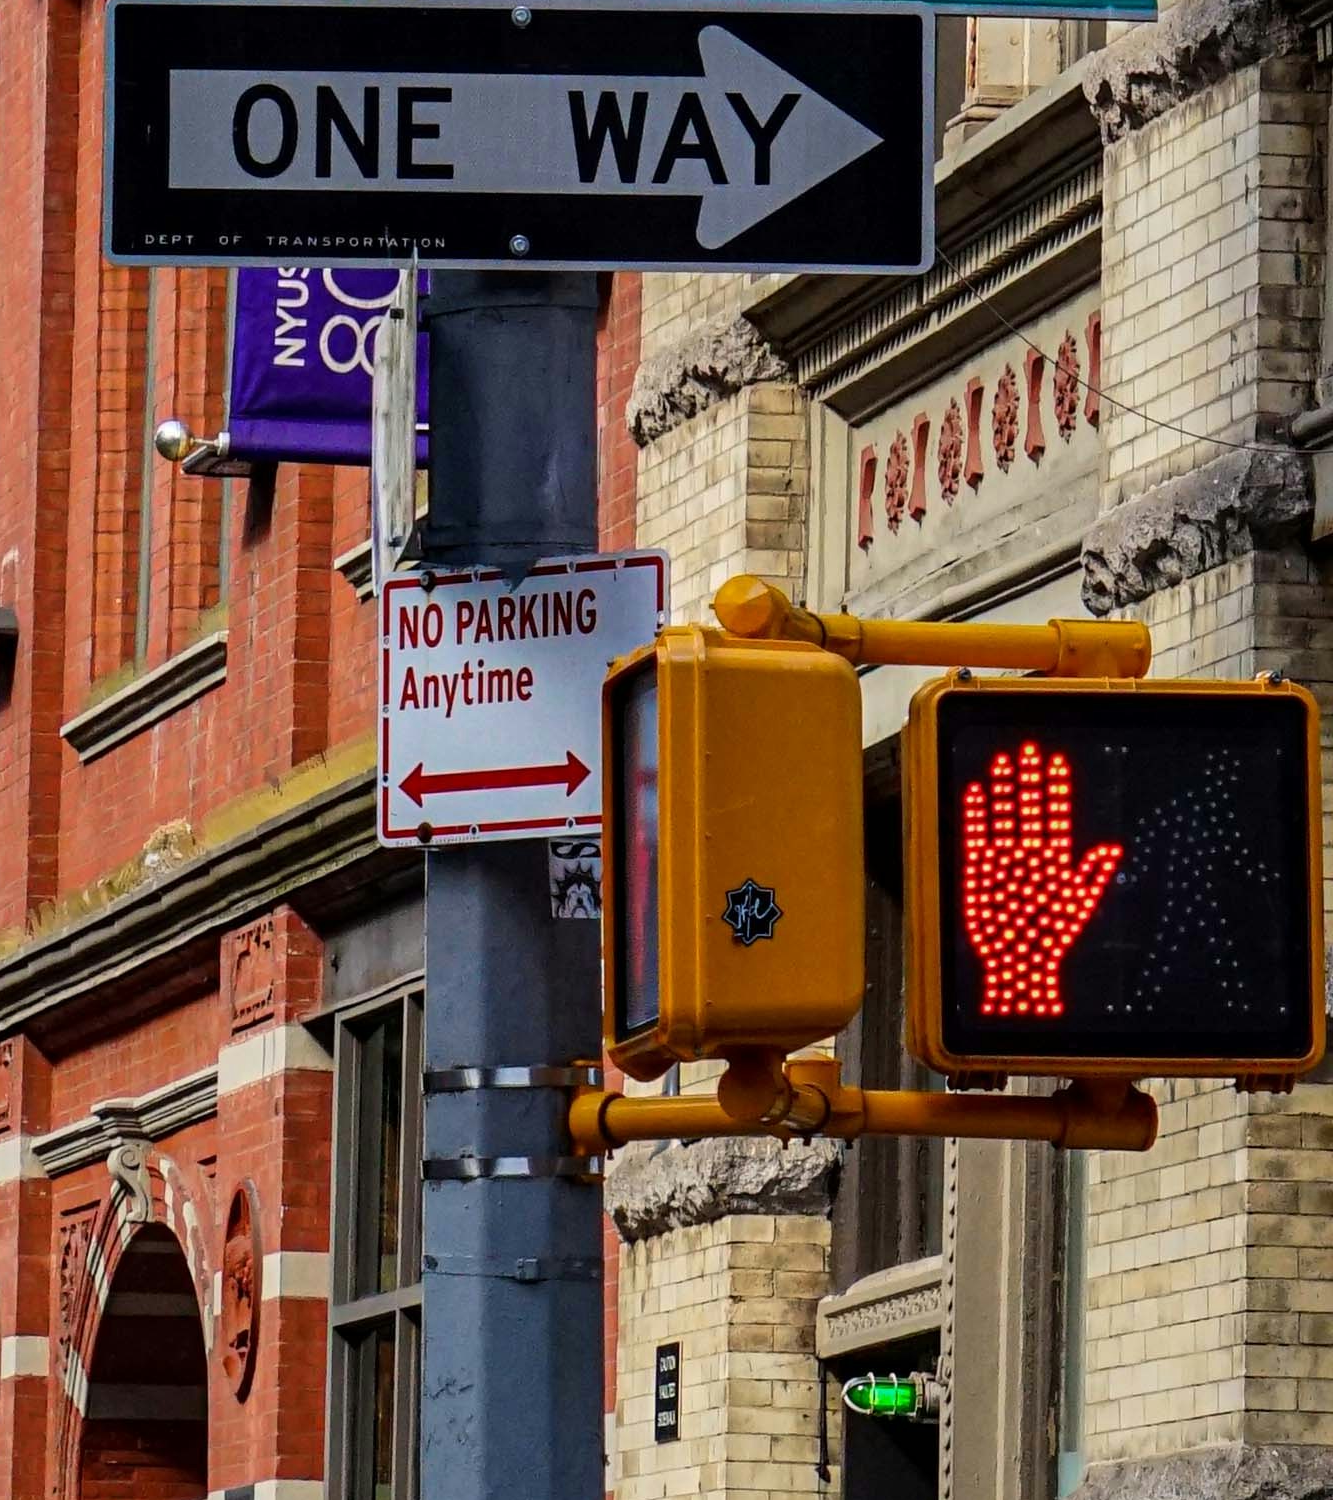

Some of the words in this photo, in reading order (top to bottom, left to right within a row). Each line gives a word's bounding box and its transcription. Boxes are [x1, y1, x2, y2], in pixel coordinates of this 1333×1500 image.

[231, 82, 455, 183] ONE
[567, 87, 803, 189] WAY
[144, 234, 194, 246] DEPT
[219, 235, 242, 246] OF
[267, 235, 446, 249] TRANSPORTATION
[398, 602, 444, 650] NO
[456, 588, 597, 646] PARKING
[399, 659, 534, 719] Anytime
